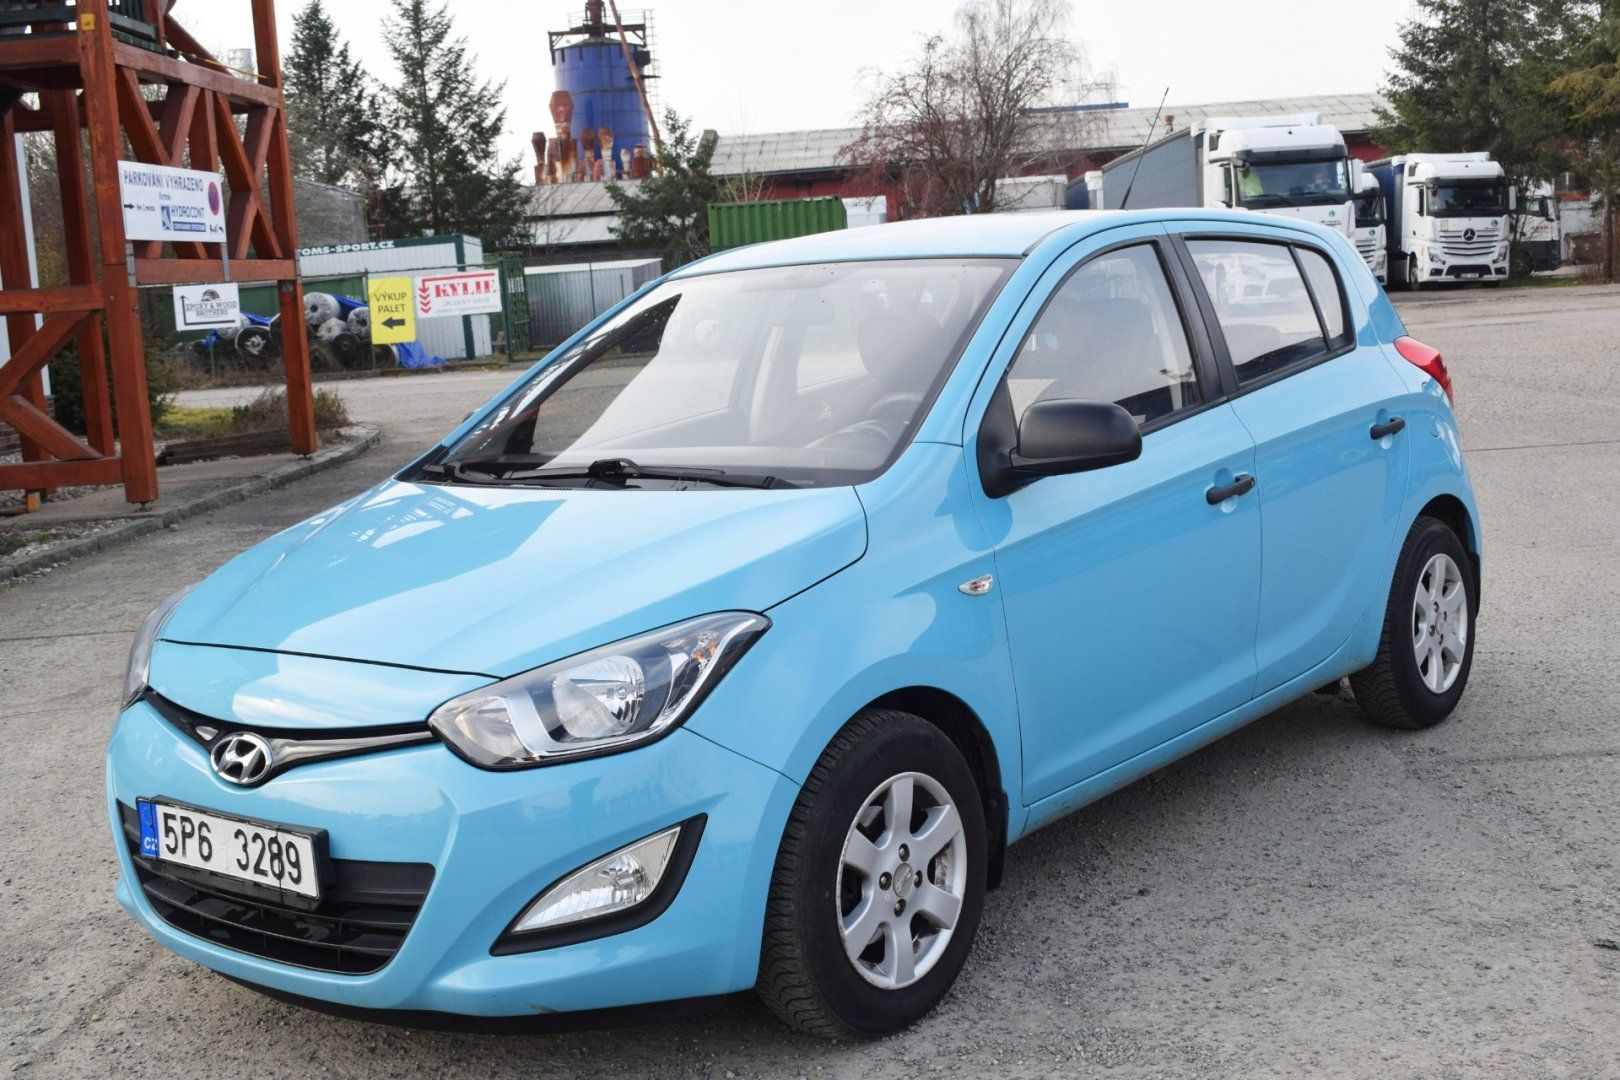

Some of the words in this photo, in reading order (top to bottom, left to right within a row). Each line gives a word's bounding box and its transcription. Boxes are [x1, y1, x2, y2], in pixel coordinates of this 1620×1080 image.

[164, 173, 203, 192] VYHRAZENO
[171, 205, 204, 218] HYDROCONT
[434, 280, 497, 298] KYLIE
[374, 291, 407, 302] VÝKUP
[186, 303, 208, 311] EPOXY
[215, 301, 238, 310] WOOD
[378, 304, 406, 313] PALET
[144, 837, 158, 850] CZ
[163, 812, 212, 862] 5P6
[234, 828, 301, 885] 3289
